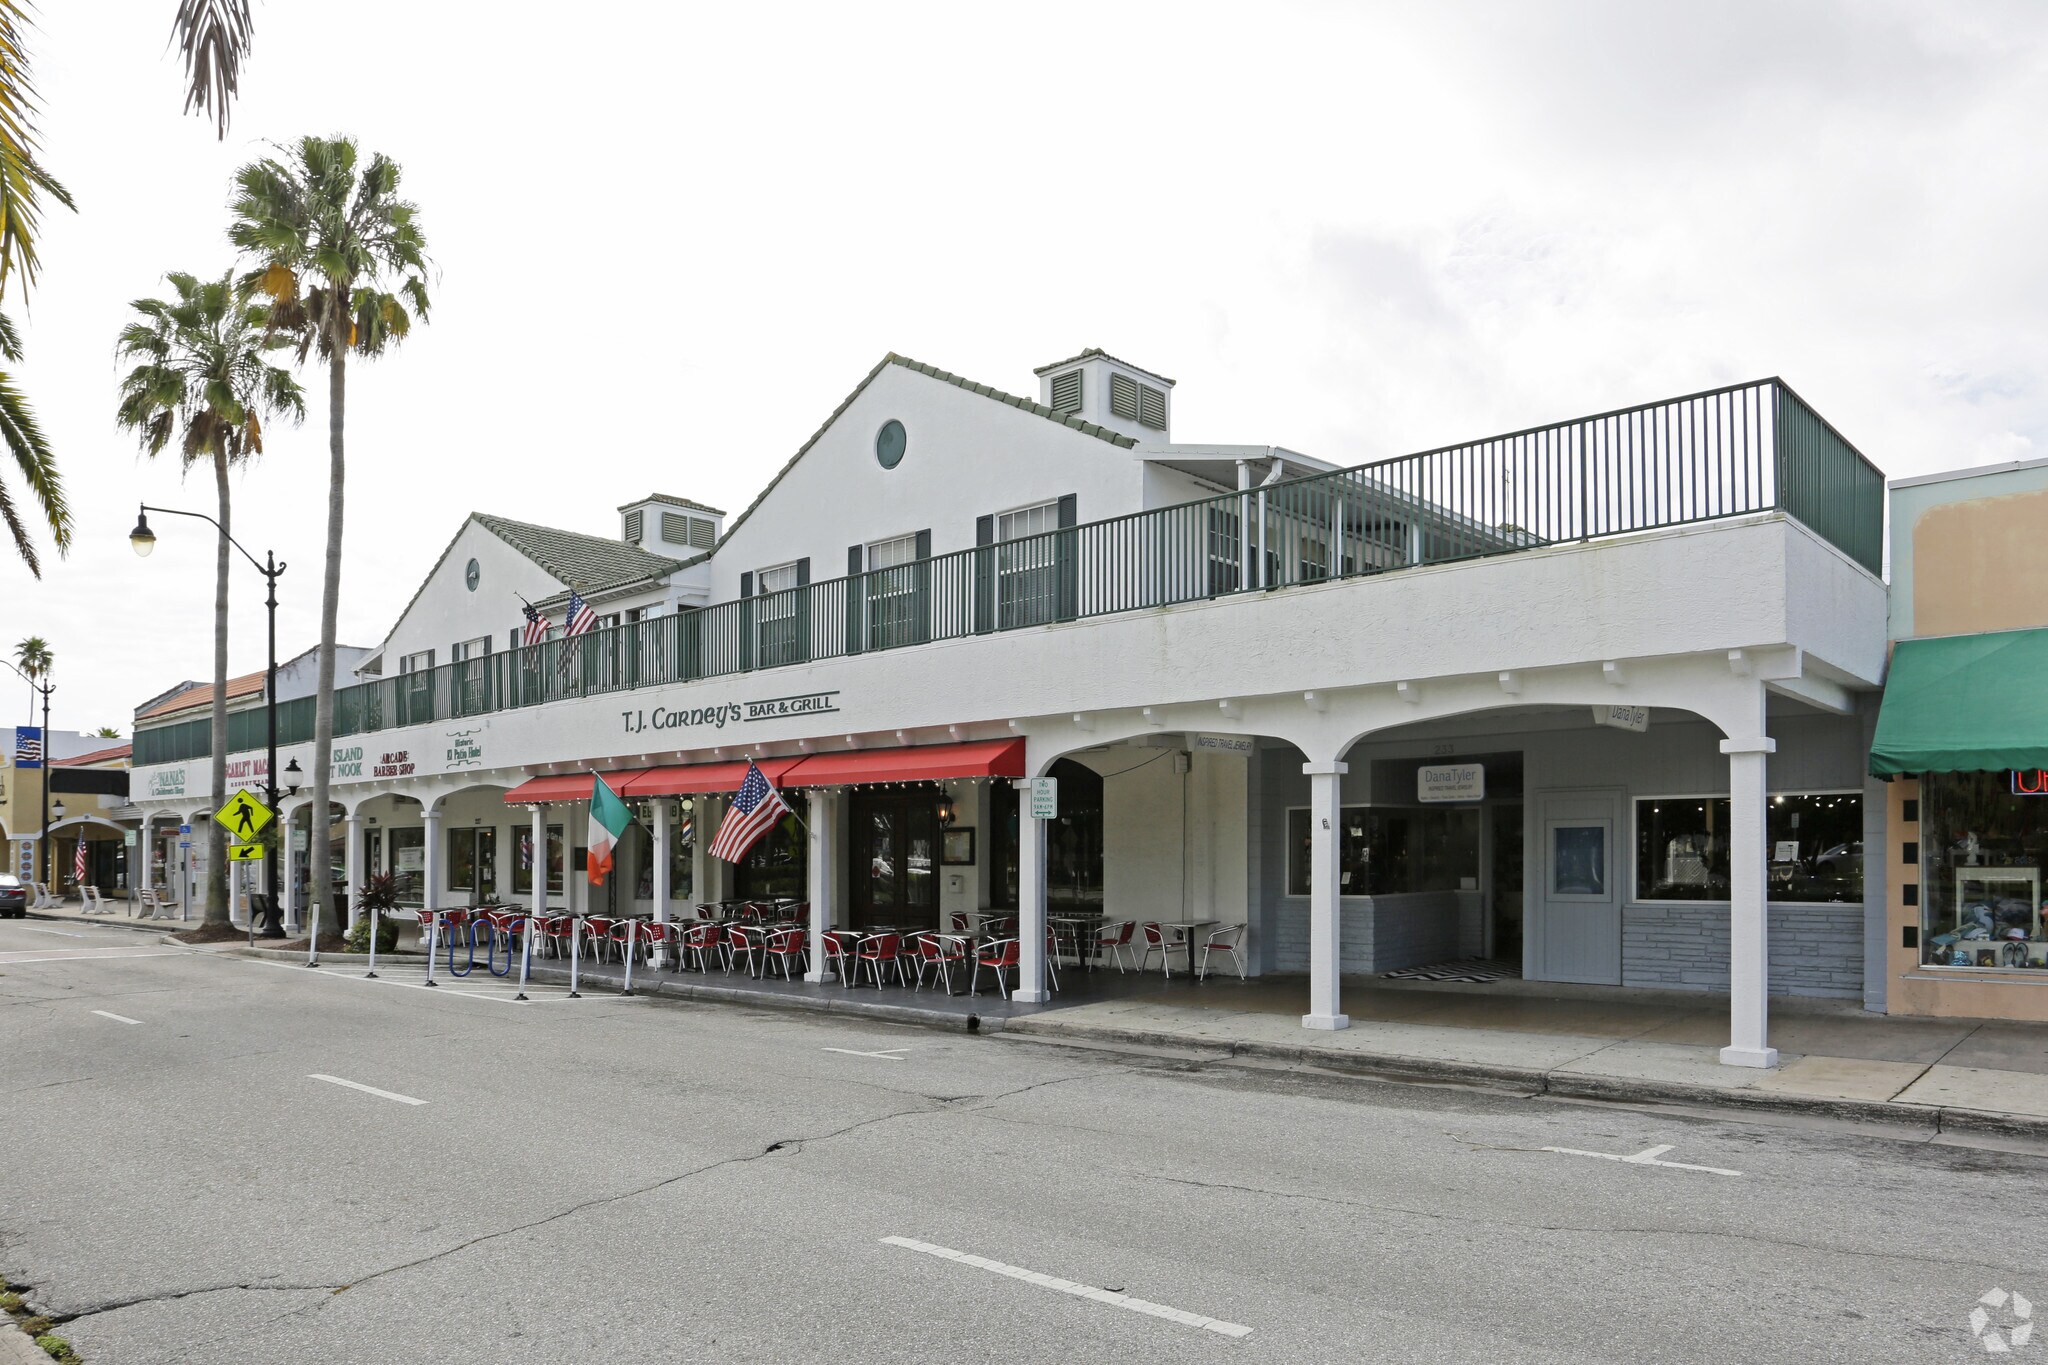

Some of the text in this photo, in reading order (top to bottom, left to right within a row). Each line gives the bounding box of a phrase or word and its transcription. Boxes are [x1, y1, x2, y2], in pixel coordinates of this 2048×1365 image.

[622, 696, 832, 733] T.J. Carney's BAR & GRILL
[333, 747, 363, 762] ISLAND
[338, 763, 362, 777] NOOK
